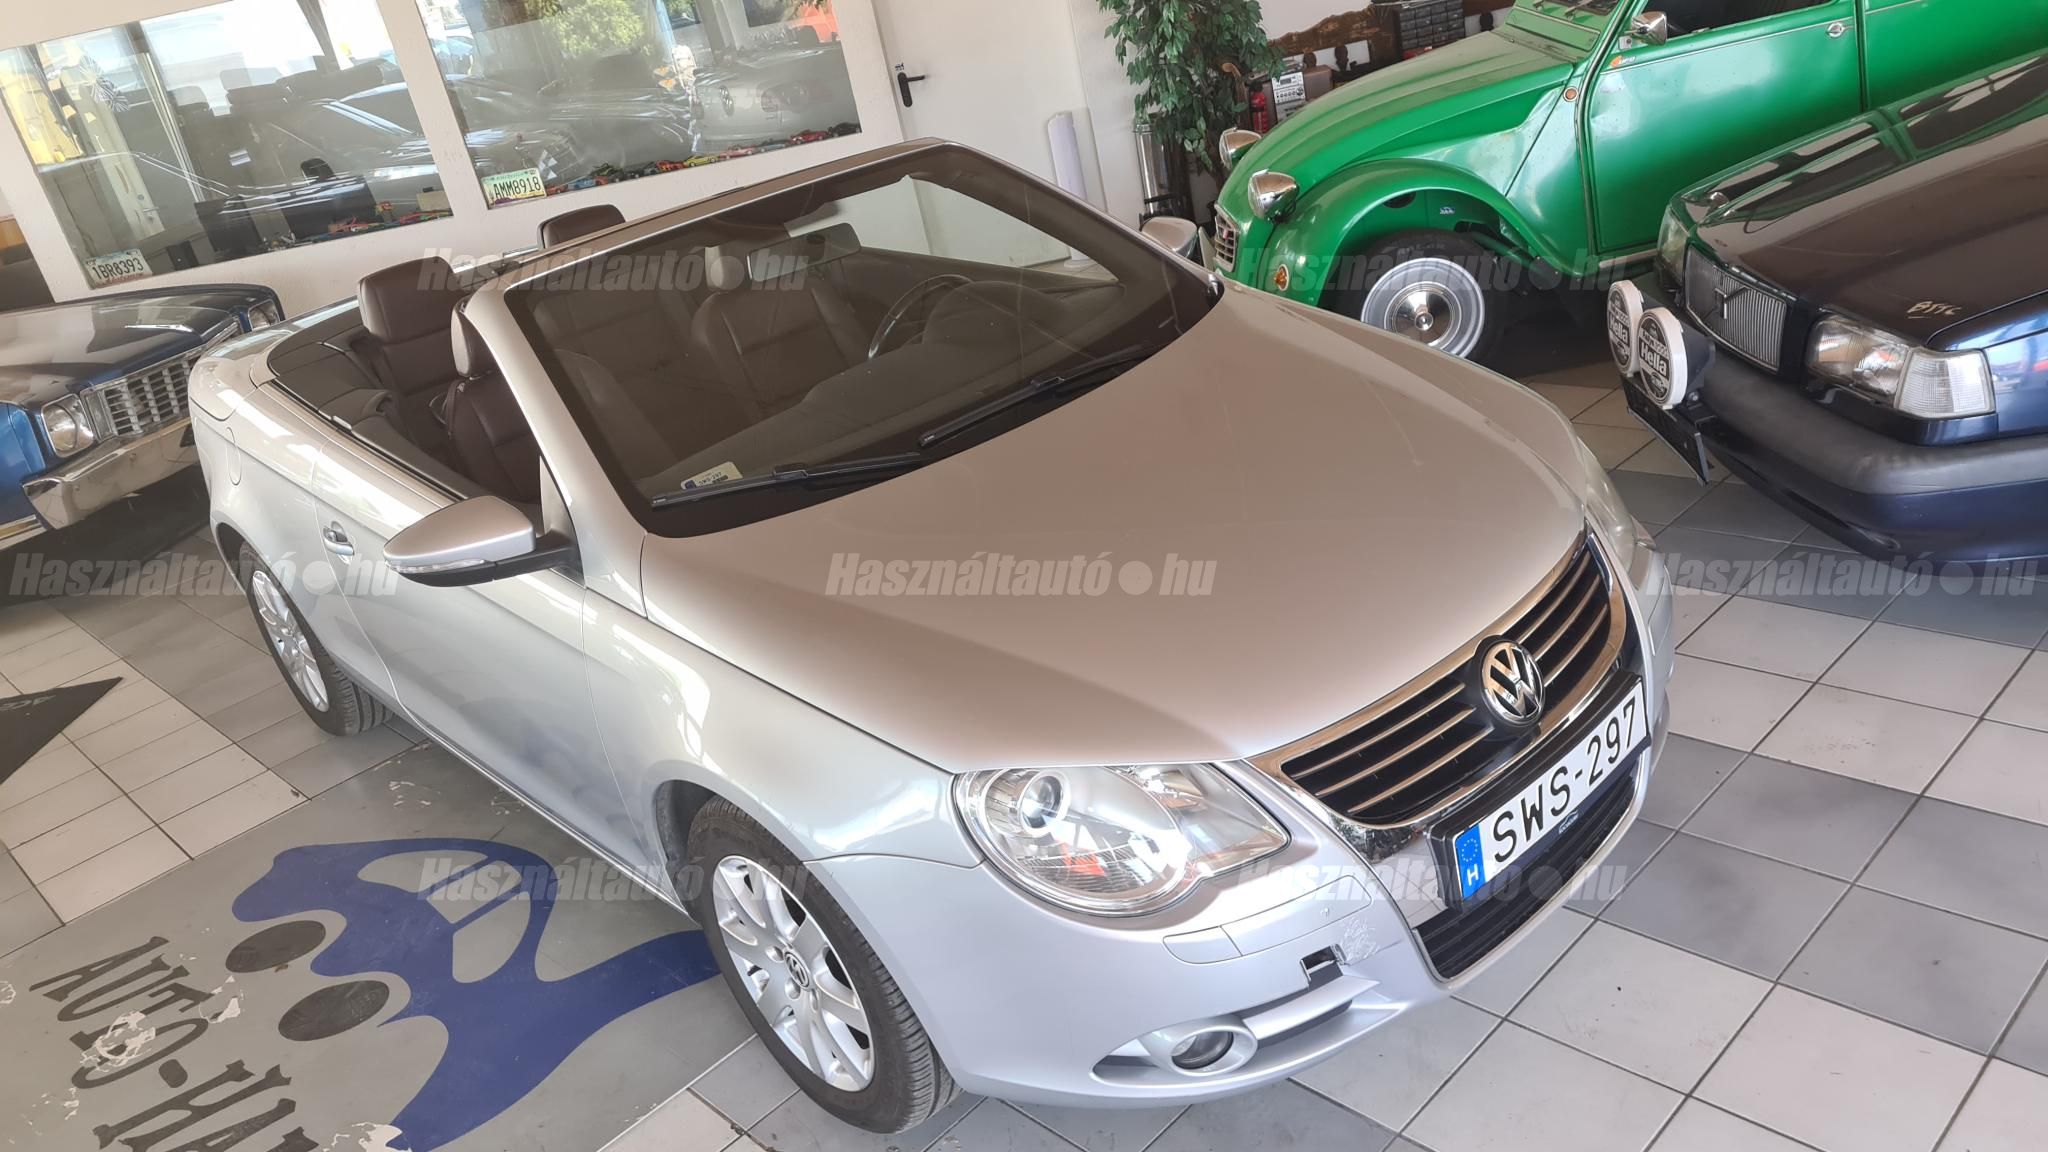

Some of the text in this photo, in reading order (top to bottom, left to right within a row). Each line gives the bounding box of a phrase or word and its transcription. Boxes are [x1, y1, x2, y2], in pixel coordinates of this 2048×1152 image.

[494, 177, 541, 199] AMM8918
[92, 258, 143, 280] 1BR8393
[1640, 345, 1669, 376] Hella
[1493, 700, 1637, 864] SWS-297
[1466, 868, 1480, 886] H
